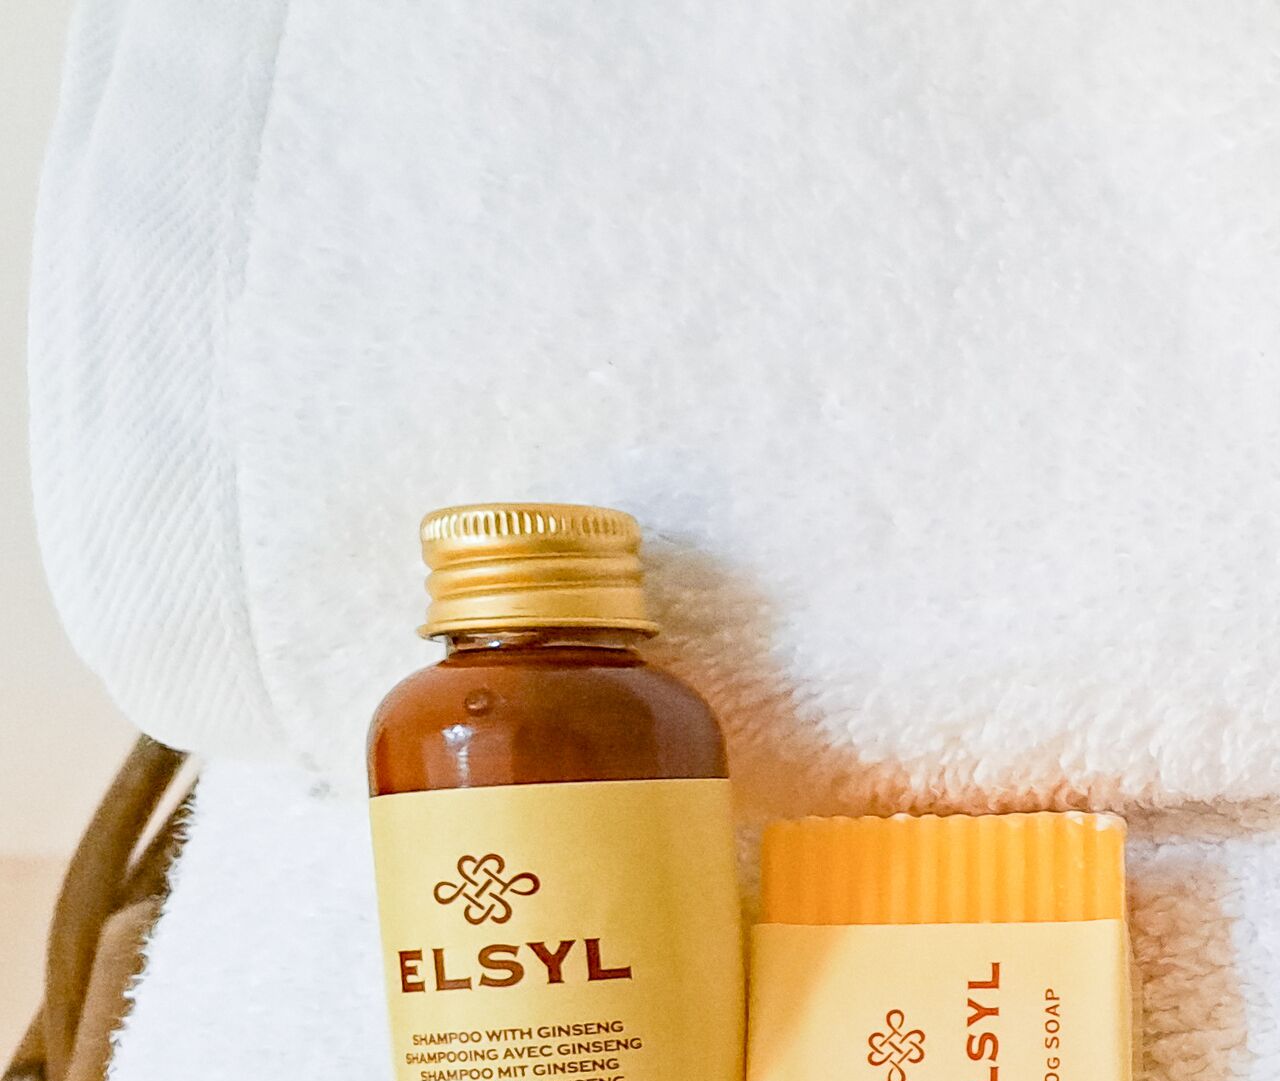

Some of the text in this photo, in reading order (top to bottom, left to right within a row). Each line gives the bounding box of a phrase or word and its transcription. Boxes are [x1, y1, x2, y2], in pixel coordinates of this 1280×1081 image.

[398, 938, 632, 993] ELSYL
[1044, 987, 1061, 1050] SOAP
[412, 1021, 624, 1046] SHAMPOO WITH GINSENG
[405, 1038, 643, 1065] SHAMPOOING AVEC GINSENG
[420, 1059, 620, 1081] SHAMPOO MIT GINSENG
